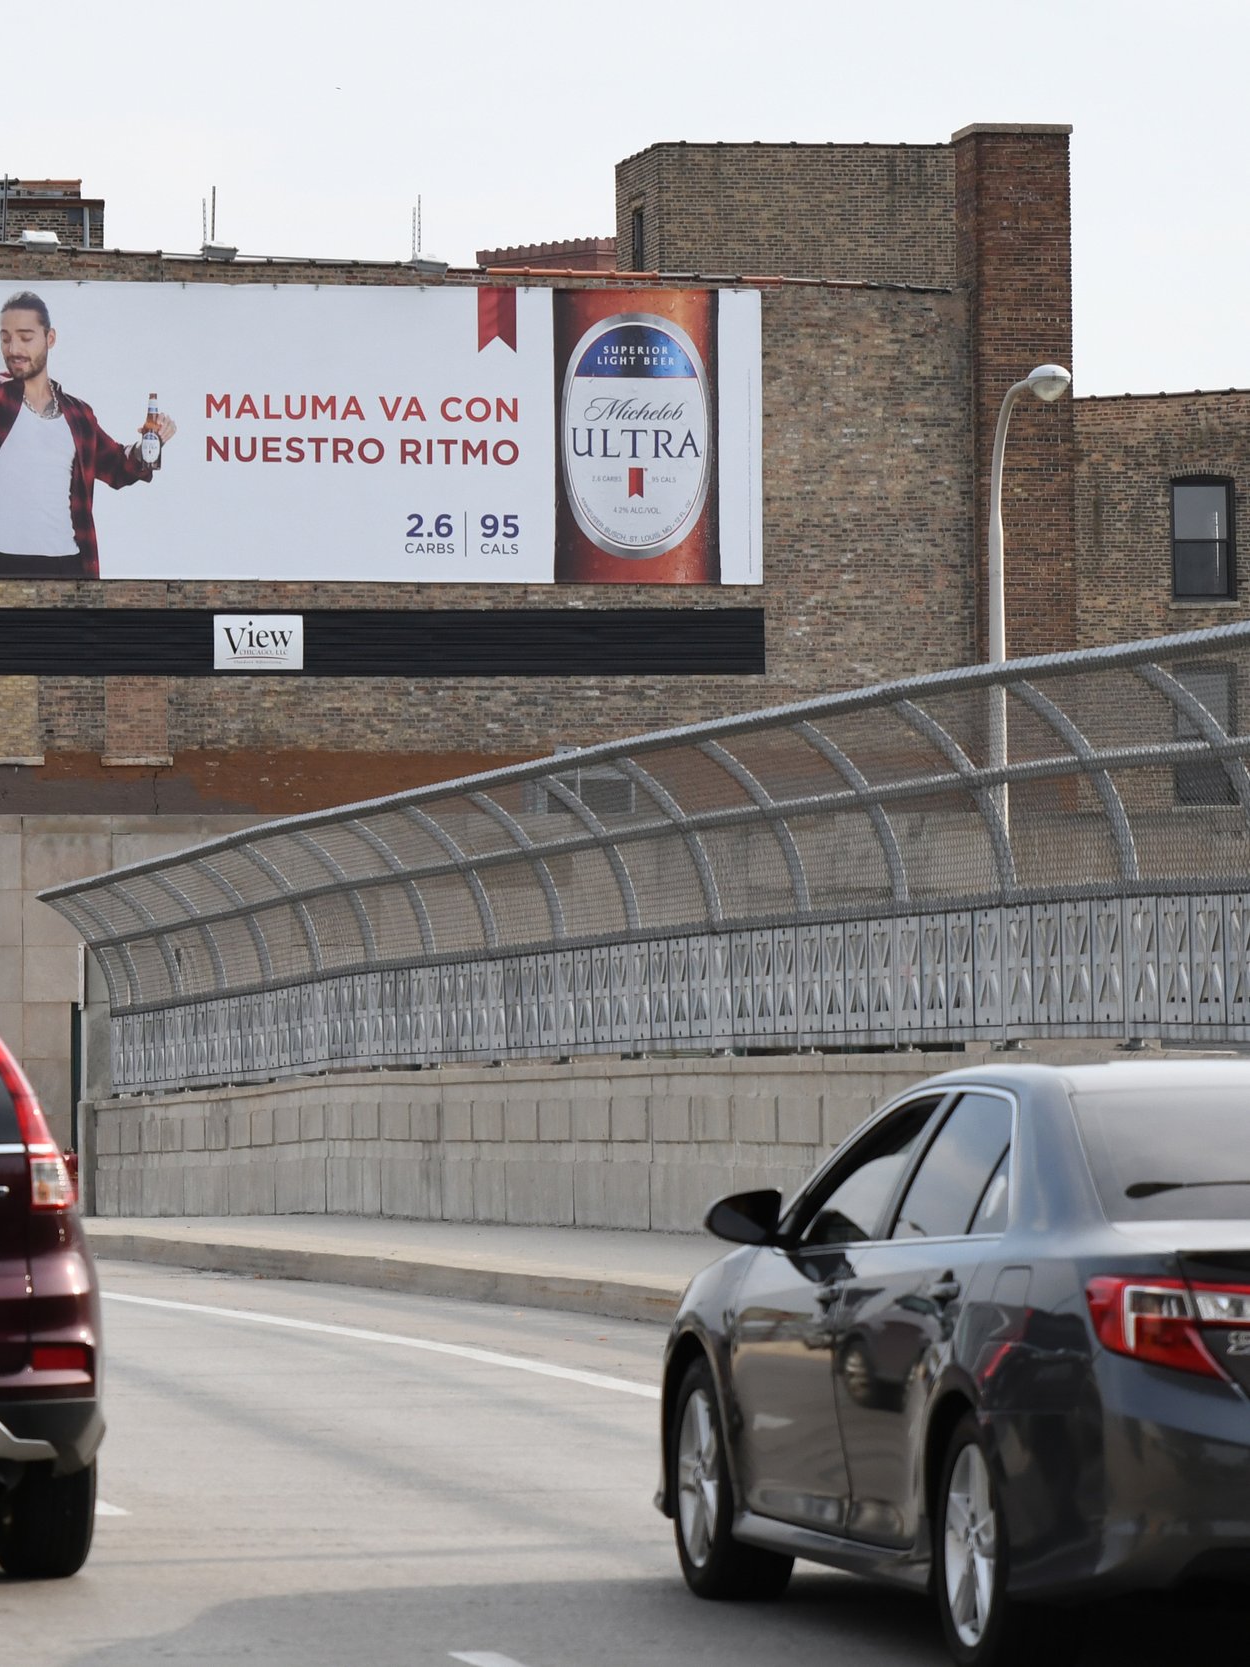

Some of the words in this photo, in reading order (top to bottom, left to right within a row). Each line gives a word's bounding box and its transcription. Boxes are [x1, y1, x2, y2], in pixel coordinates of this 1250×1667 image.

[597, 356, 636, 365] LIGHT
[643, 357, 675, 366] BEER
[603, 345, 668, 355] SUPERIOR
[205, 393, 366, 421] MALUMA
[378, 396, 427, 422] VA
[440, 396, 519, 423] CON
[583, 397, 687, 422] Michelob
[206, 435, 385, 464] NUESTRO
[400, 438, 520, 466] RITMO
[571, 427, 700, 458] ULTRA
[406, 513, 453, 538] 2.6
[480, 514, 520, 539] 95
[405, 543, 455, 554] CARBS
[480, 543, 519, 555] CALS
[223, 620, 293, 655] View
